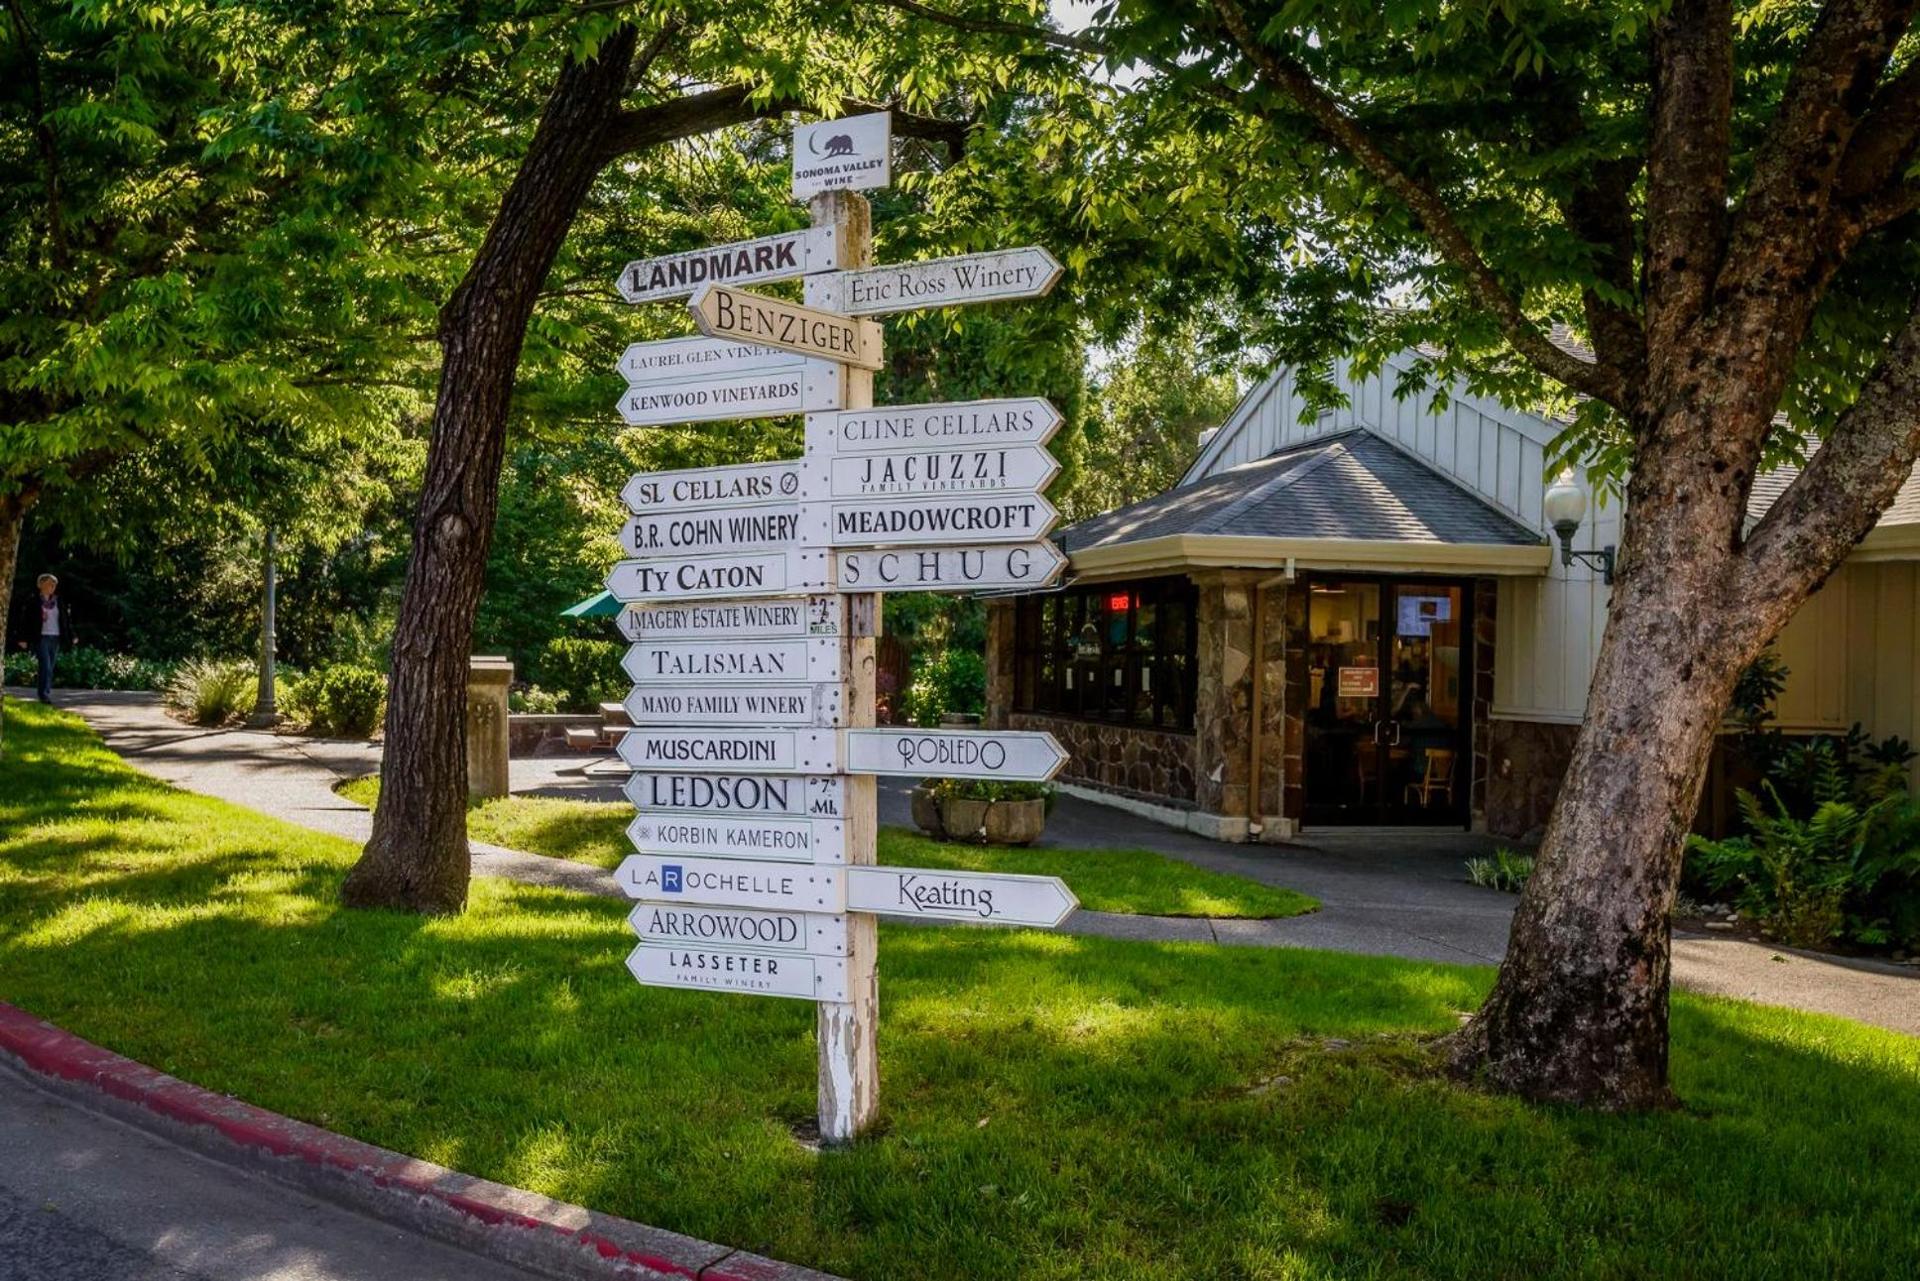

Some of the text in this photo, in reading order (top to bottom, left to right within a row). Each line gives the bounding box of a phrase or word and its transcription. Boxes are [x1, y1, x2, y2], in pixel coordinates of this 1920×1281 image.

[795, 159, 884, 179] SONOMA VALLEY
[824, 176, 853, 186] WINE
[631, 240, 797, 293] LANDMARK
[851, 264, 1037, 303] Eric Ross Winery
[715, 290, 857, 355] BENZIGER
[630, 354, 685, 370] LAUREL
[686, 349, 723, 364] GLEN
[630, 382, 799, 412] KENWOOD VINEYARDS
[843, 410, 1034, 441] CLINE CELLARS
[860, 451, 1007, 484] JACUZZI
[640, 475, 773, 505] SL CELLARS
[861, 478, 1007, 493] FAMILY VINEYARDS
[634, 513, 799, 549] B.R. COHN WINERY
[837, 504, 1036, 535] MEADOWCROFT
[636, 564, 764, 593] TY CATON
[844, 547, 1032, 584] SCHUG
[629, 606, 800, 630] IMAGERY ESTATE WINERY
[651, 650, 786, 674] TALISMAN
[641, 696, 807, 714] MAYO FAMILY WINERY
[645, 739, 776, 761] MUSCARDINI
[897, 737, 1006, 770] ROBLEDO
[649, 775, 789, 811] LEDSON
[657, 825, 809, 849] KORBIN KAMERON
[898, 874, 993, 918] Keating
[649, 908, 798, 943] ARROWOOD
[669, 951, 779, 975] LASSETER
[677, 974, 771, 989] FAMILY WINERY
